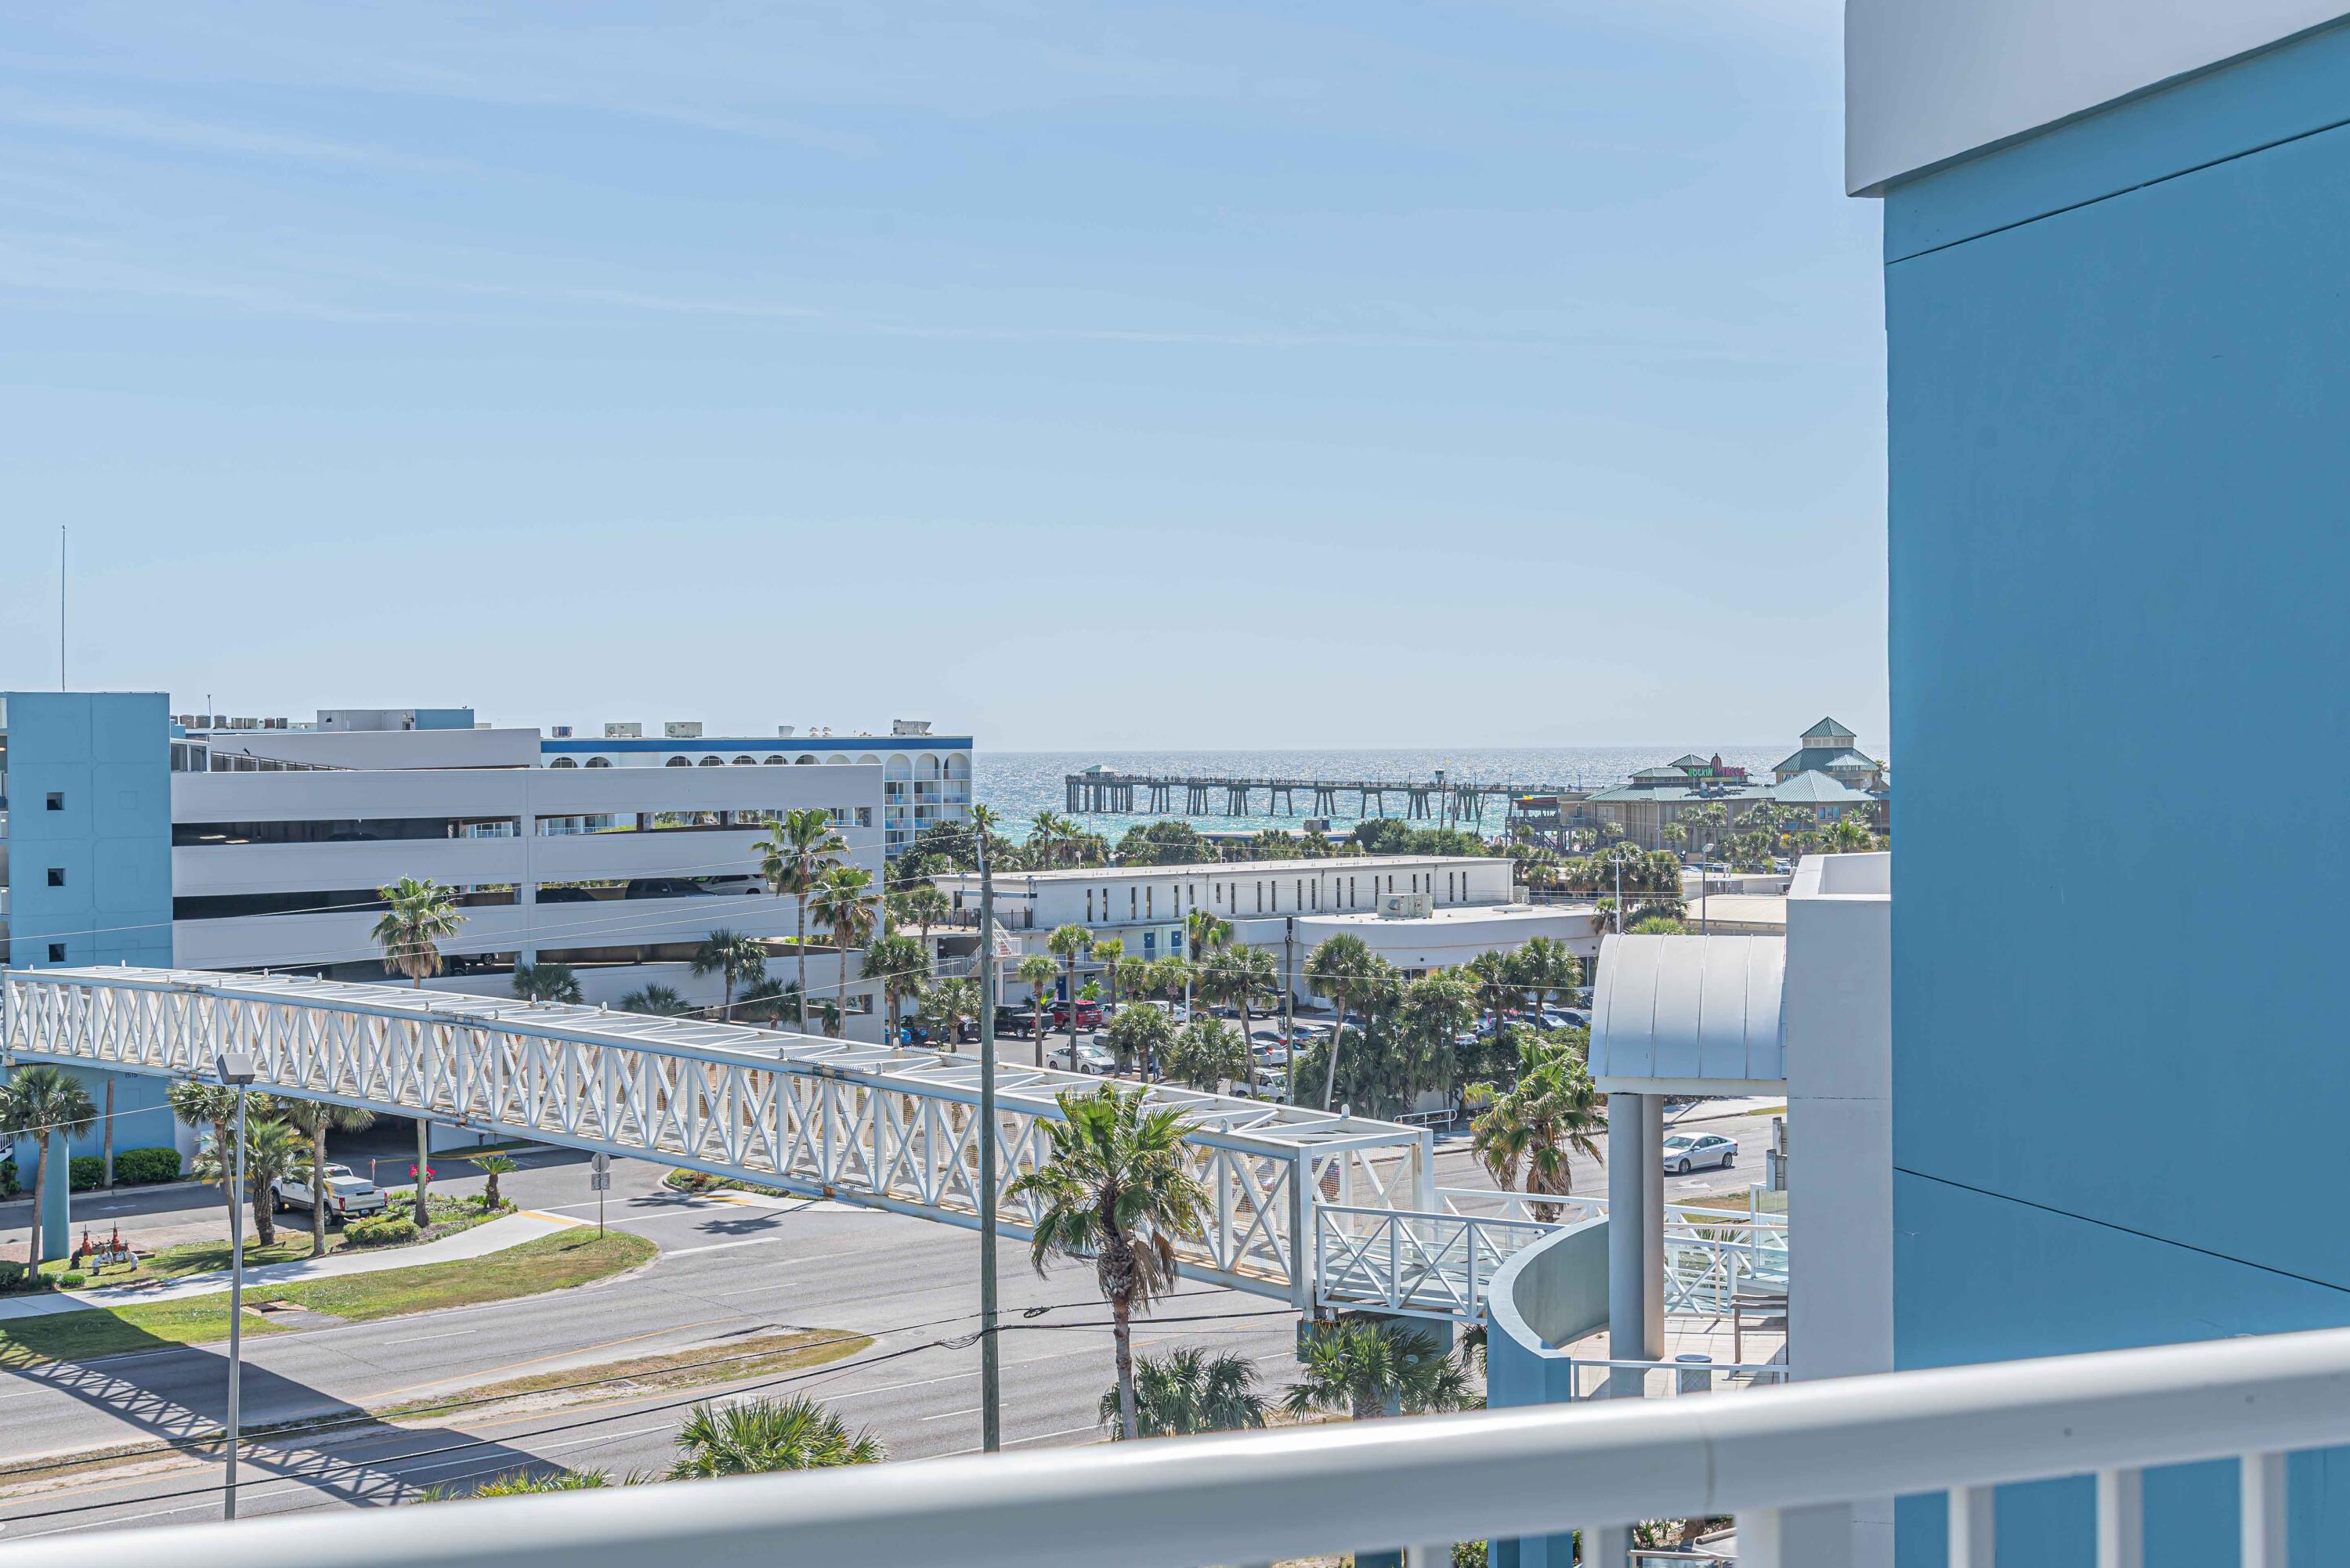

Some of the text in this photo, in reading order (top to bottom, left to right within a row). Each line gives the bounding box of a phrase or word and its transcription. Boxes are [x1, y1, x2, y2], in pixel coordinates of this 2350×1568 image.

[1688, 767, 1713, 777] ROCKIN
[644, 814, 652, 826] 4
[863, 811, 870, 825] 5
